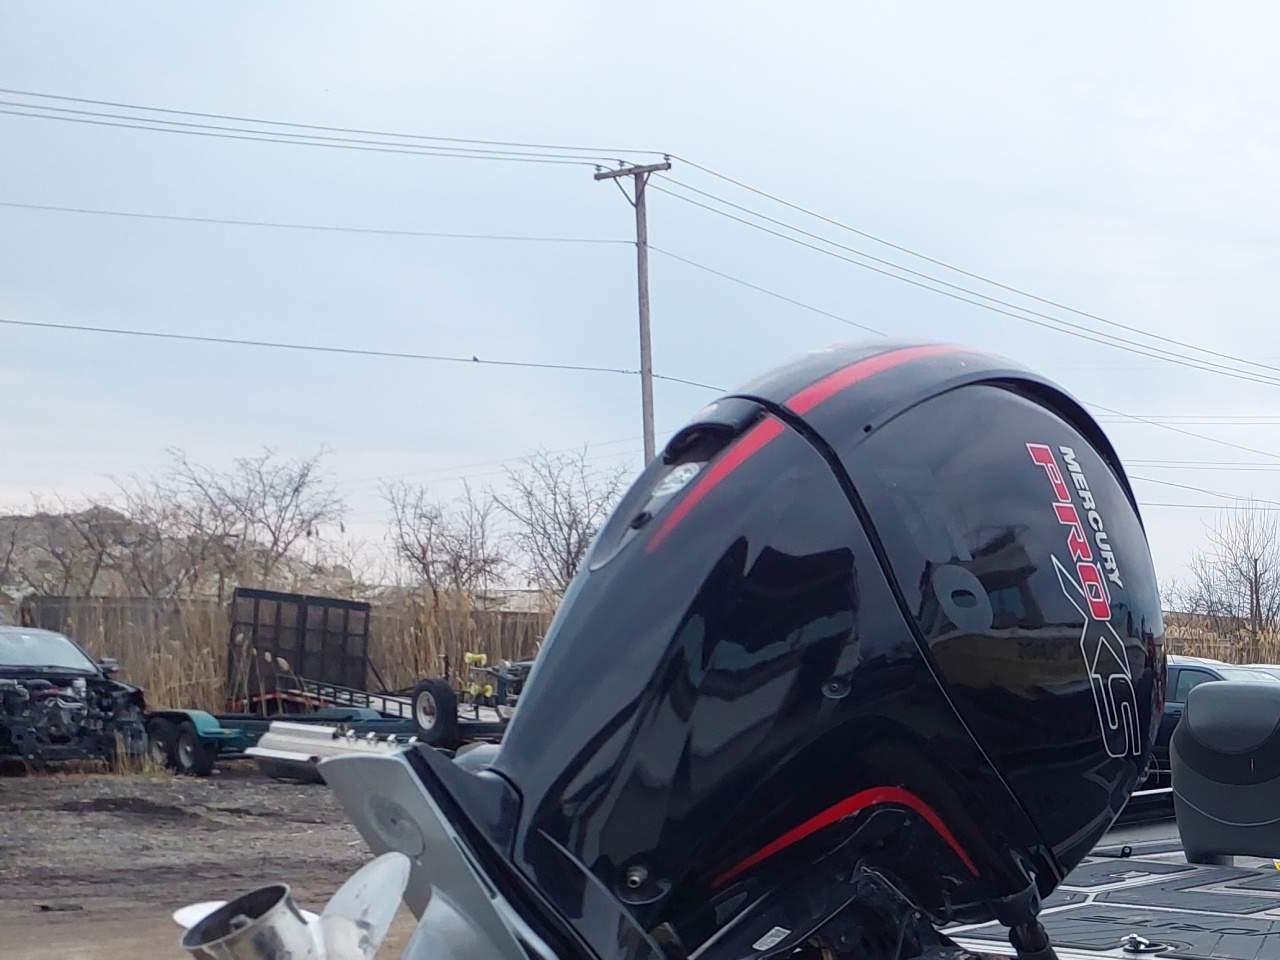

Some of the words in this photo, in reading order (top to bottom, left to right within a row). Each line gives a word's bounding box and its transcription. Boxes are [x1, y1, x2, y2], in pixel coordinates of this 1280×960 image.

[1026, 442, 1111, 621] PRO
[1059, 446, 1123, 589] MERCURY
[1051, 554, 1142, 758] XS
